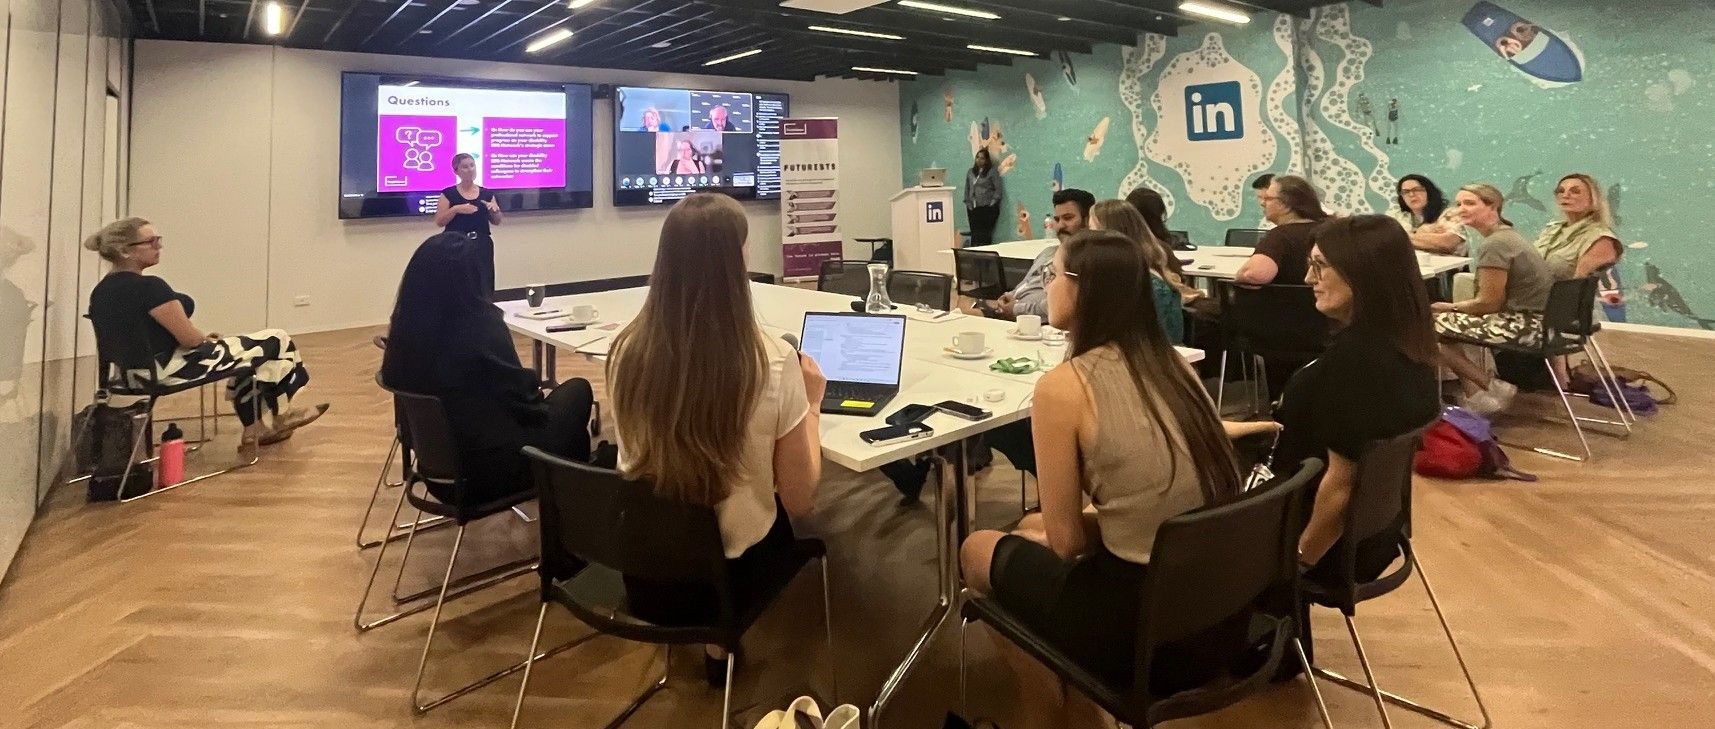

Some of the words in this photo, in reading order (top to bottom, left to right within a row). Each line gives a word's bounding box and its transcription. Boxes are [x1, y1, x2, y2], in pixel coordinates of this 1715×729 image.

[387, 95, 450, 107] Questions
[1191, 92, 1235, 133] in
[928, 204, 942, 220] in
